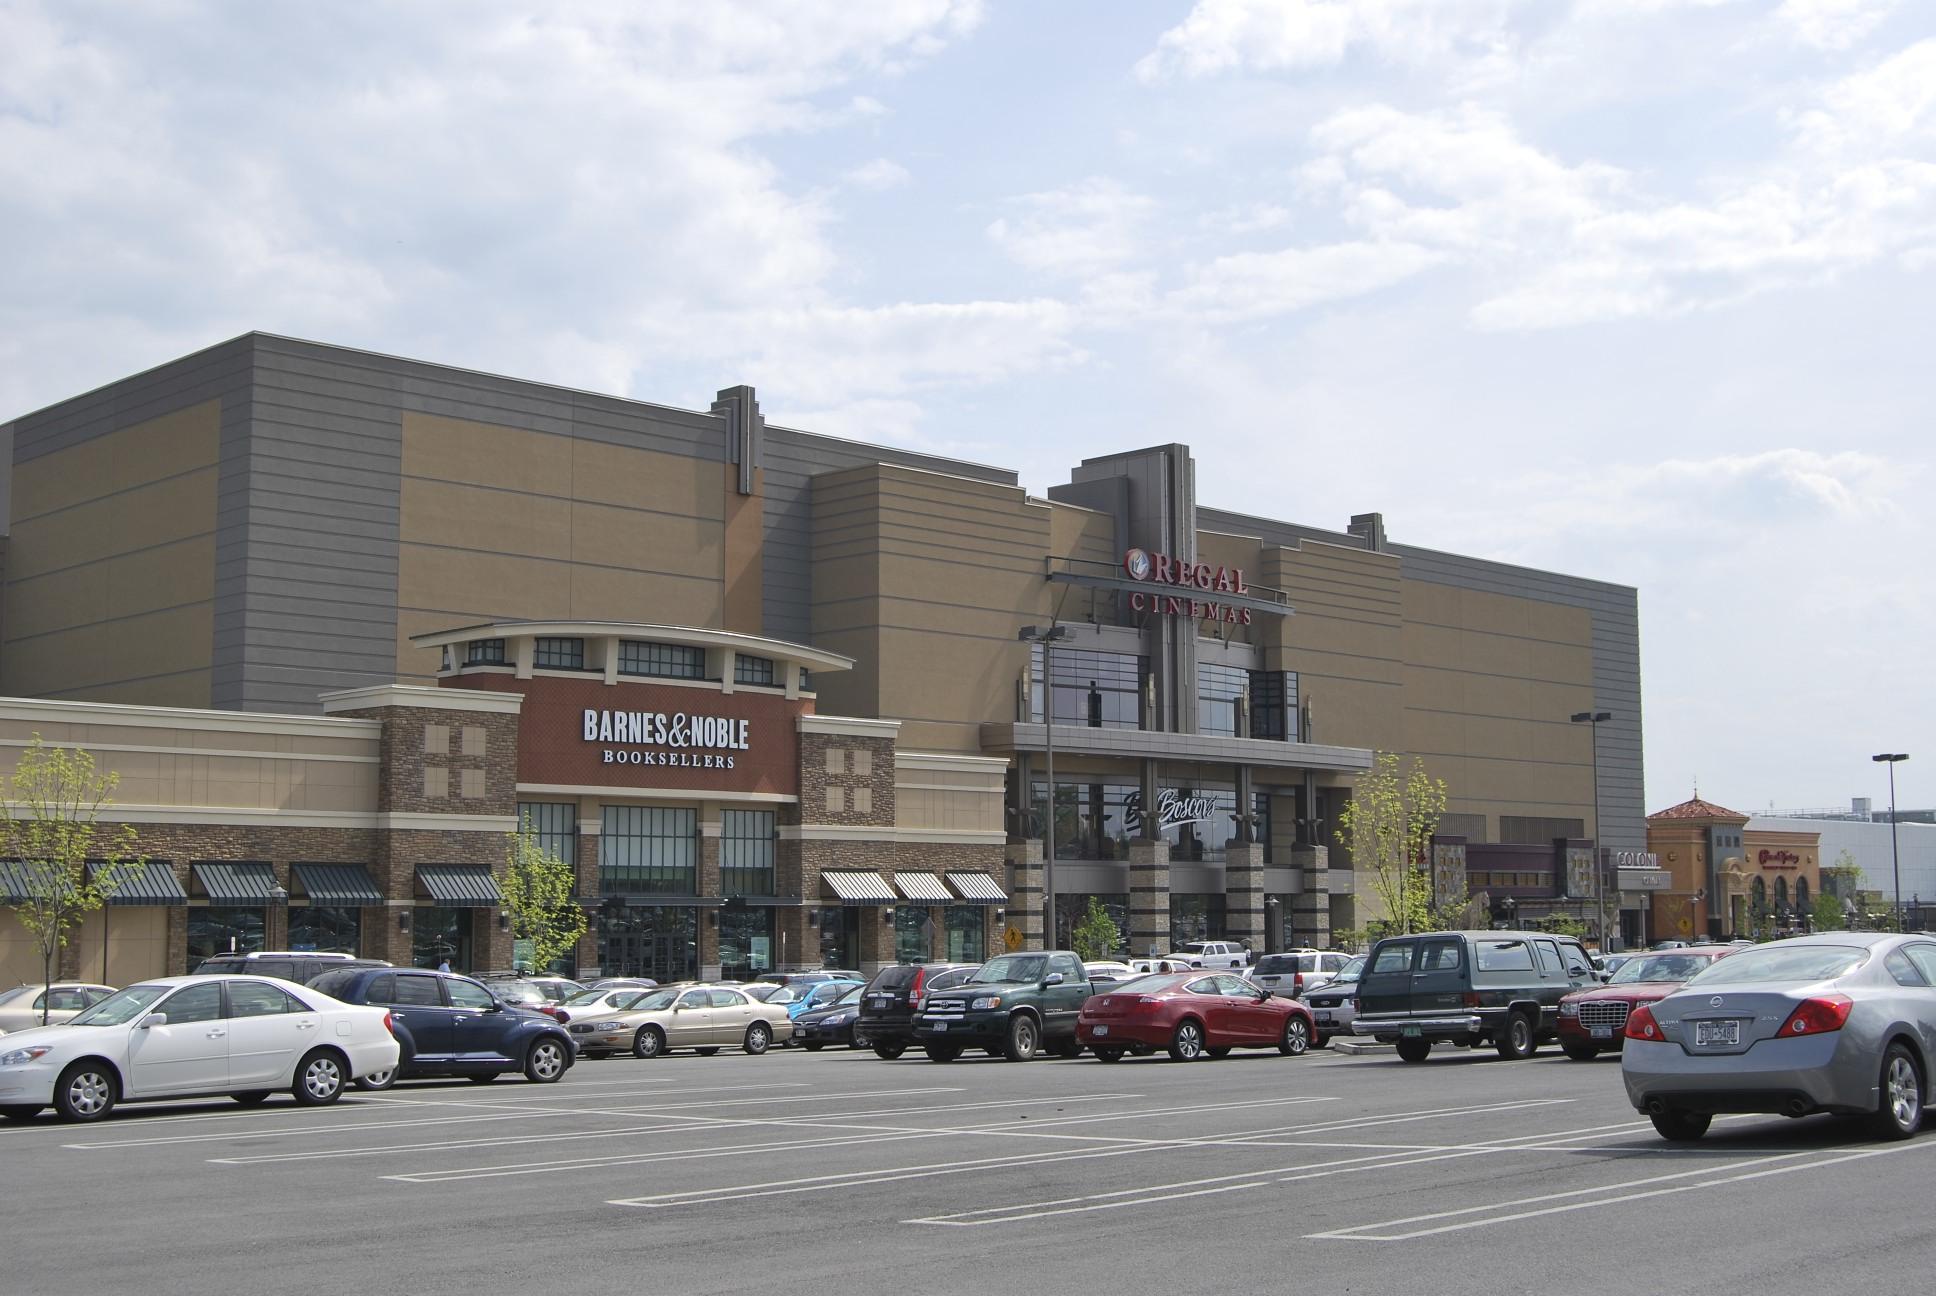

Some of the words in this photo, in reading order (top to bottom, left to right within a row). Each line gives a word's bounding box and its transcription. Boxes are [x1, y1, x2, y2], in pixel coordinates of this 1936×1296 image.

[1152, 552, 1249, 594] REGAL
[1129, 592, 1252, 625] CINEMAS
[603, 750, 735, 769] BOOKSELLERS
